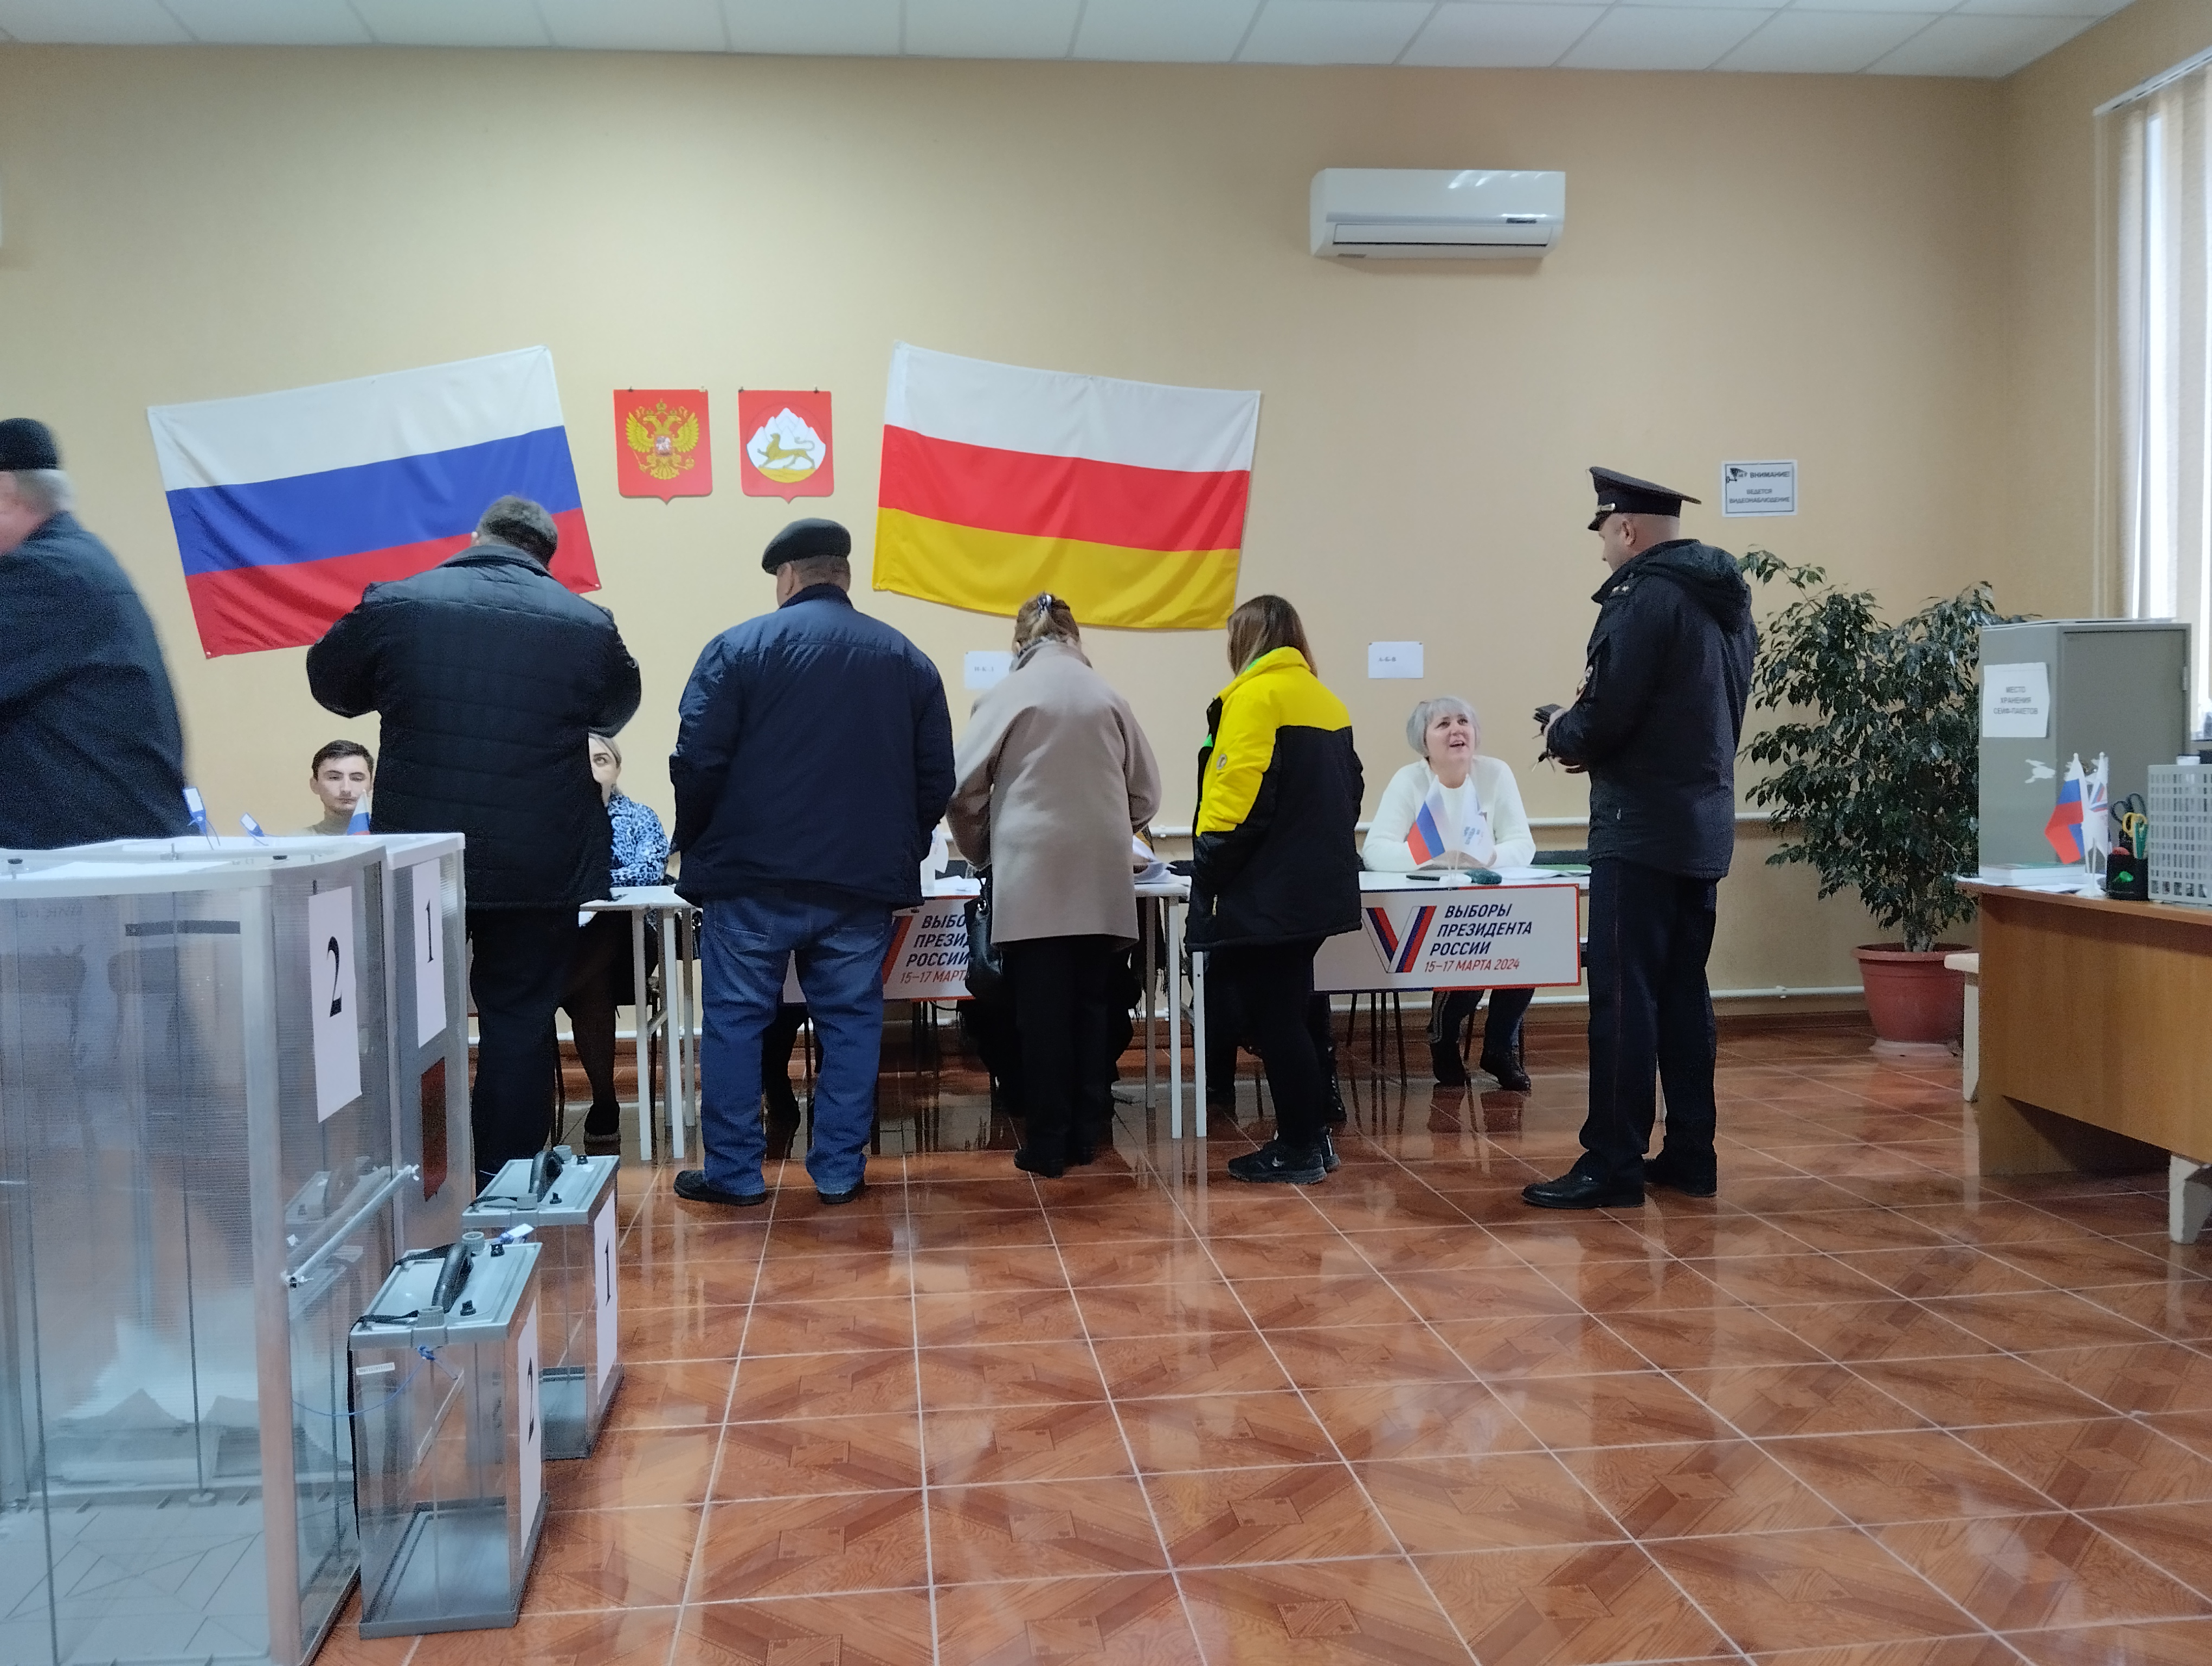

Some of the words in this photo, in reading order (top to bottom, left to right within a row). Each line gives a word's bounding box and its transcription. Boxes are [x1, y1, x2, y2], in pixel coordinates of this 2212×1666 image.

[425, 898, 434, 963] 1
[1437, 921, 1532, 938] ПРЕЗИДЕНТА
[1444, 904, 1513, 918] ВЫБОРЫ
[1430, 941, 1491, 956] РОССИИ
[1455, 959, 1491, 971] МАРТА
[1494, 958, 1520, 970] 2024
[326, 935, 343, 1018] 2
[604, 1236, 611, 1307] 1
[526, 1356, 535, 1446] 2
